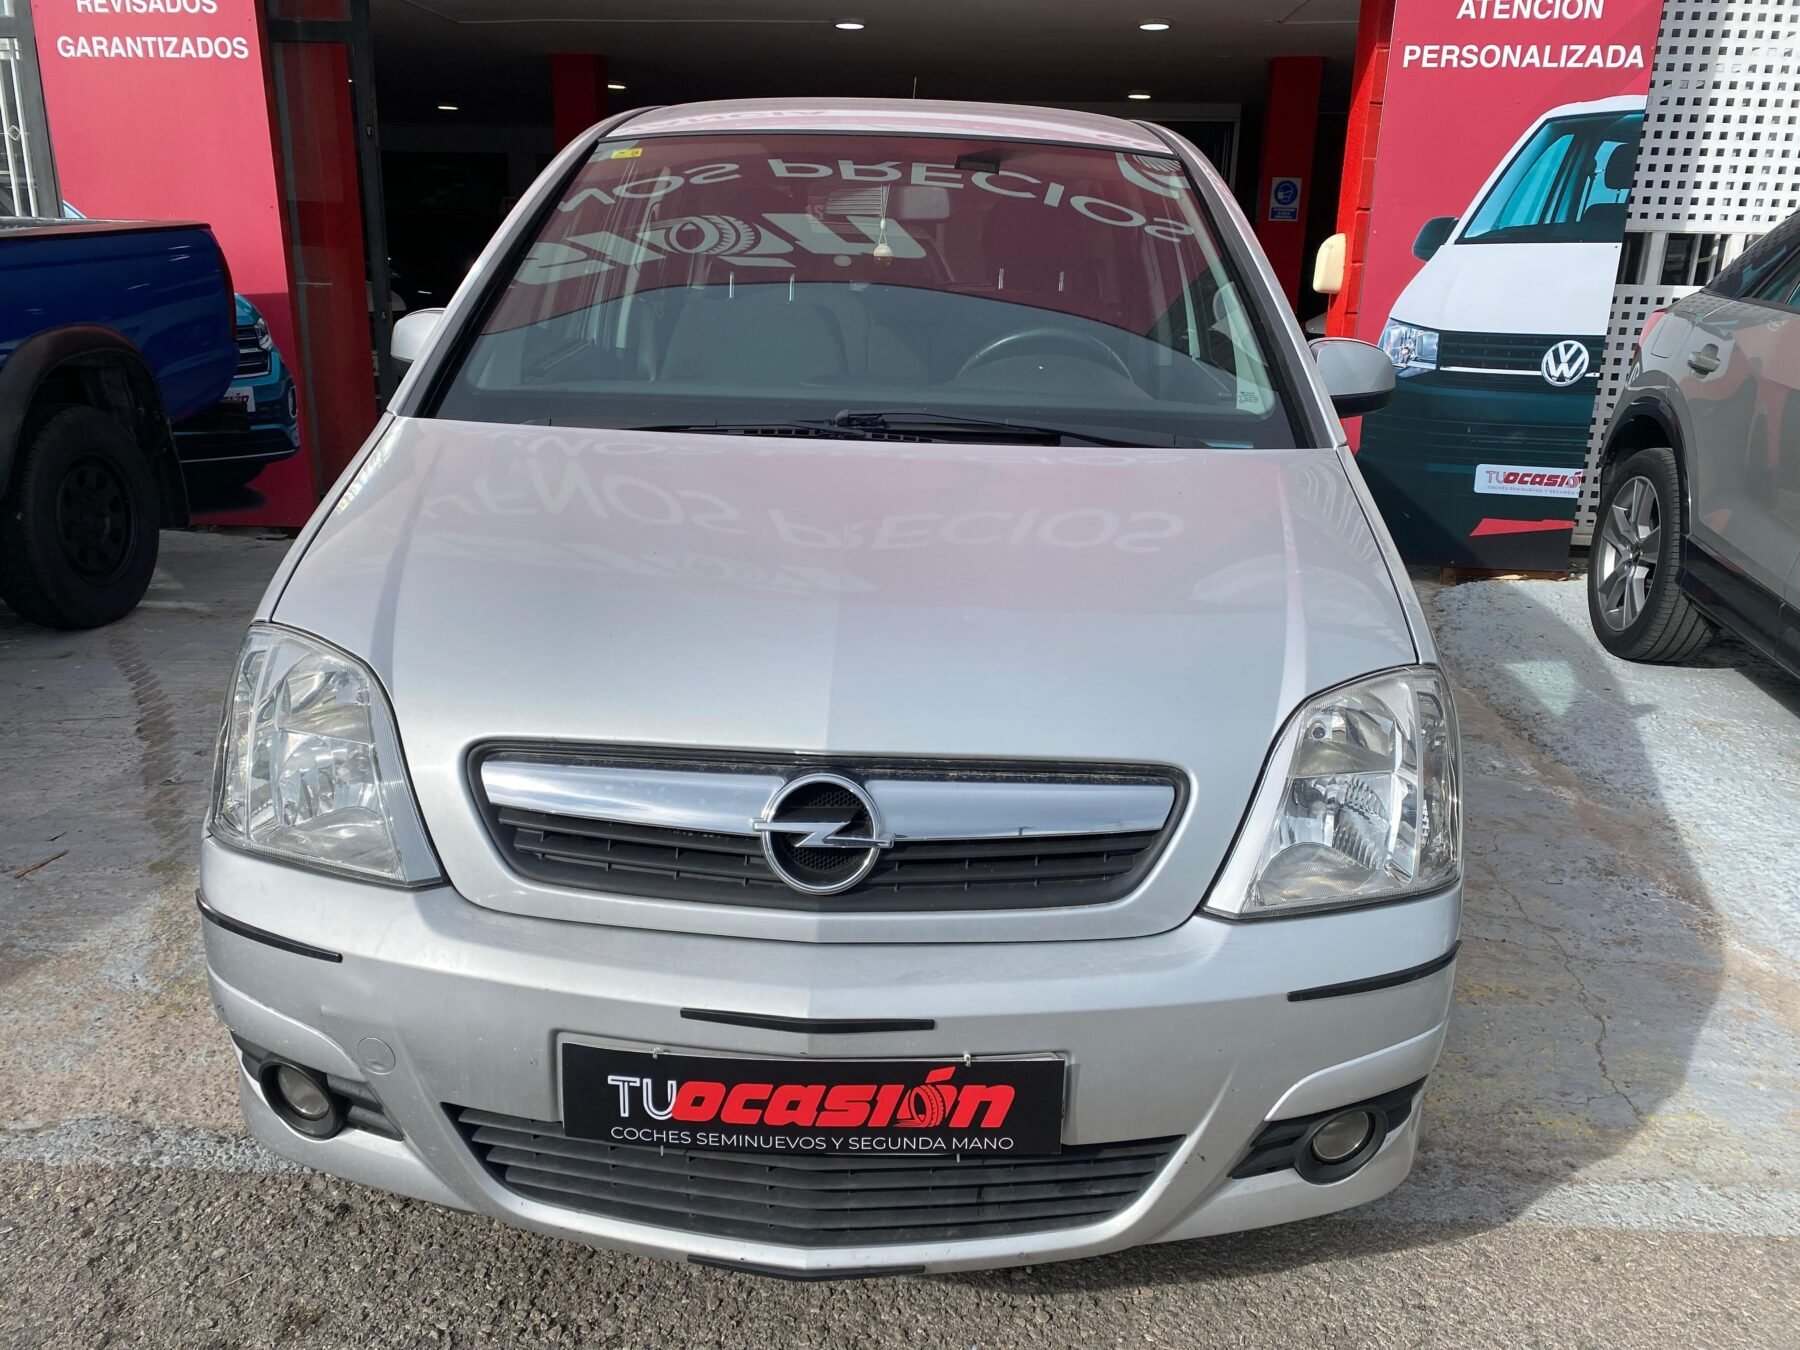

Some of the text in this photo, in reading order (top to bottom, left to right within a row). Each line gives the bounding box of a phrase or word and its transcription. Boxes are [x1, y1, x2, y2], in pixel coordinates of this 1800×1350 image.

[76, 0, 218, 14] REVISADOS
[56, 36, 249, 59] GARANTIZADOS
[1402, 44, 1645, 68] PERSONALIZADA
[610, 1126, 1014, 1150] COCHES SEMINUEVOS Y SEGUNDA MANO
